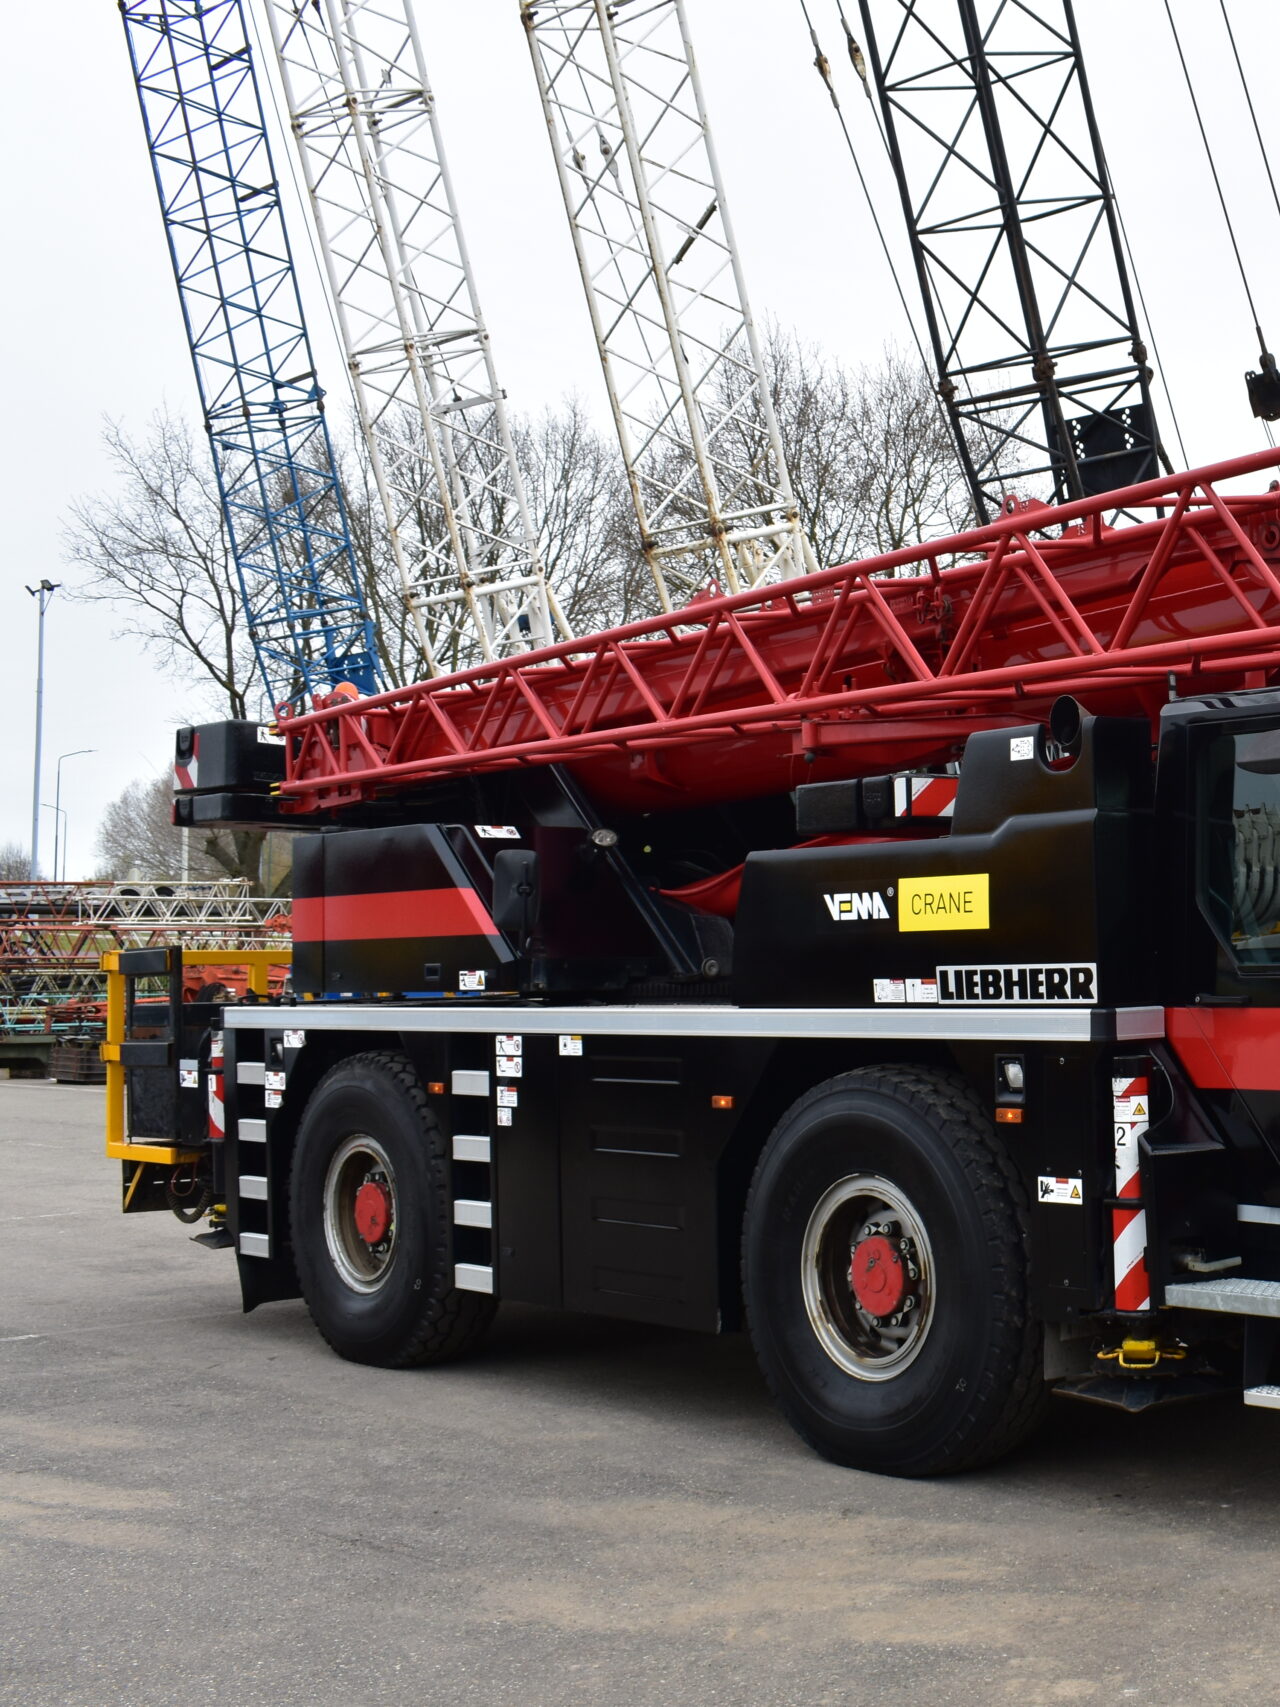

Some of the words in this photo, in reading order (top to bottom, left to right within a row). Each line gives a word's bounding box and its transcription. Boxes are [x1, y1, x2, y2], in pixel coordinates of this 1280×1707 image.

[823, 892, 890, 921] VEMA
[911, 891, 974, 915] CRANE
[939, 967, 1095, 1001] LIEBHERR
[1116, 1126, 1126, 1146] 2
